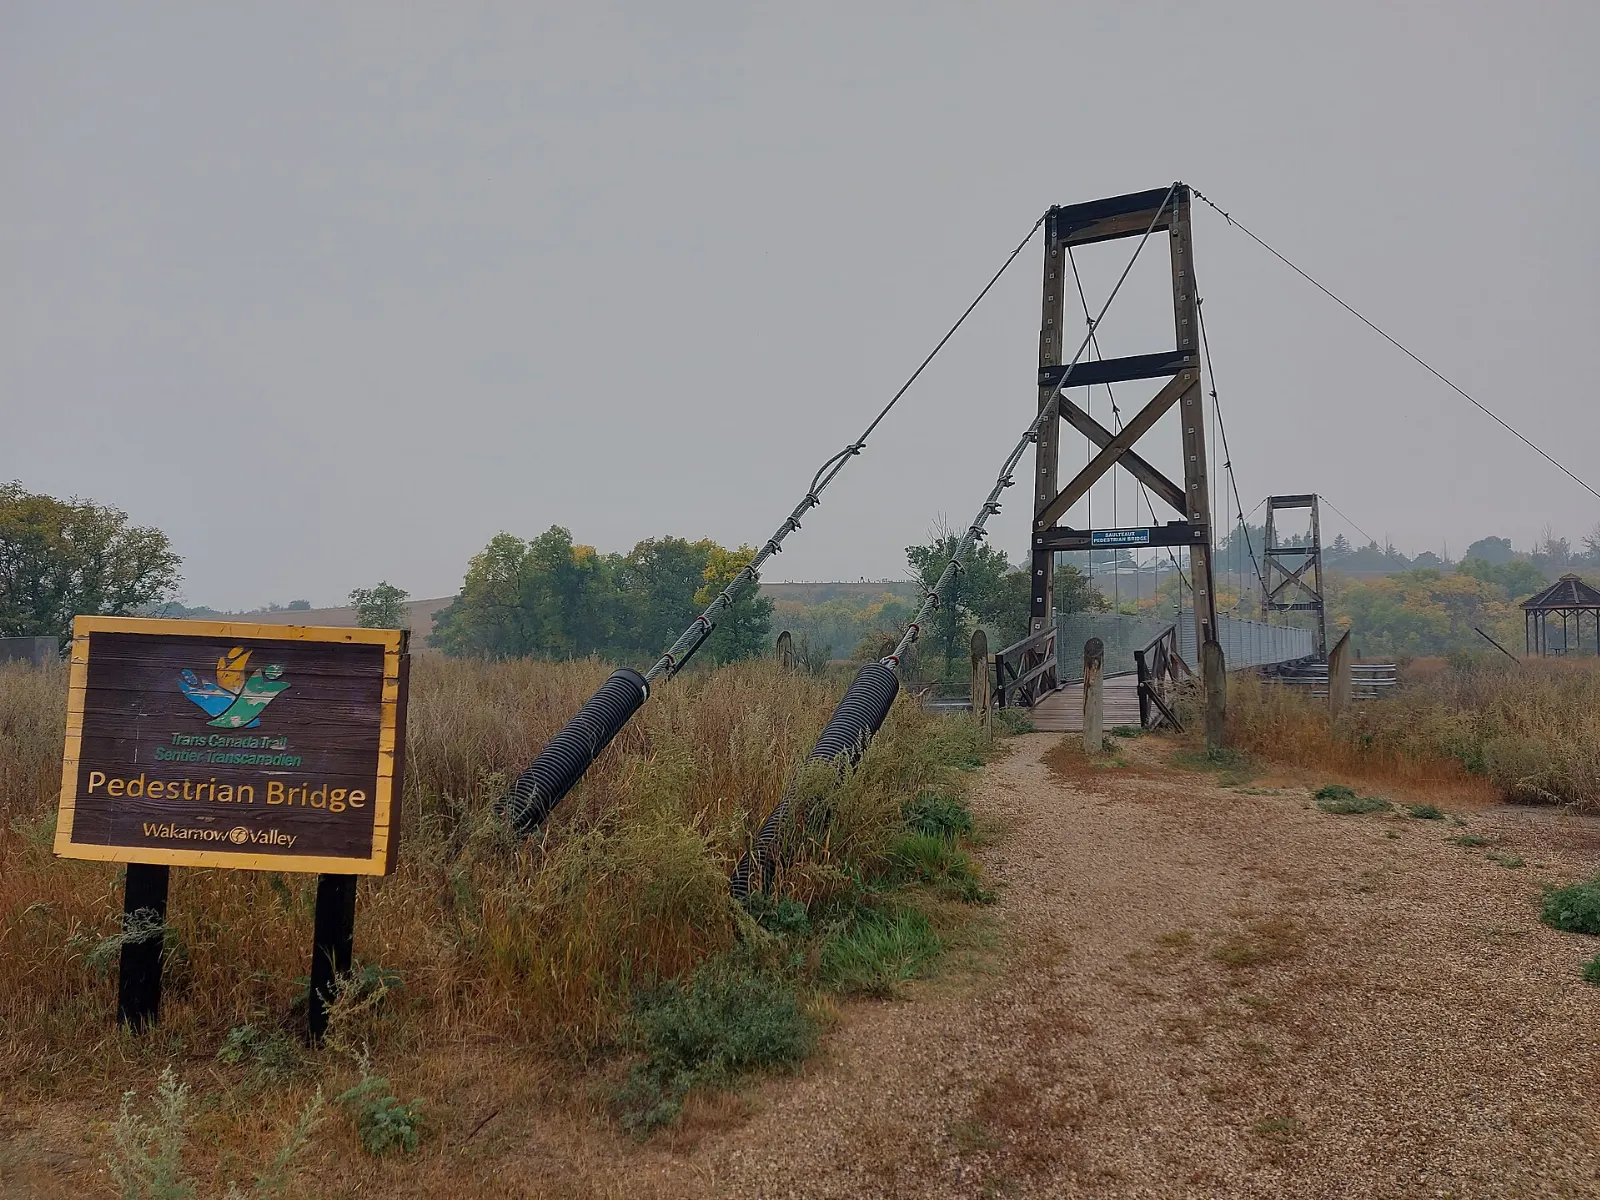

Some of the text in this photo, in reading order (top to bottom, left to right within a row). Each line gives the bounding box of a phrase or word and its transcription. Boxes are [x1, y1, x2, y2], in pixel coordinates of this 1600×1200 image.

[171, 732, 288, 750] Trans Canada Trail
[154, 746, 303, 767] Sentier Transcanadien
[87, 771, 366, 813] Pedestrian Bridge
[143, 822, 297, 849] Wakamow Valley
